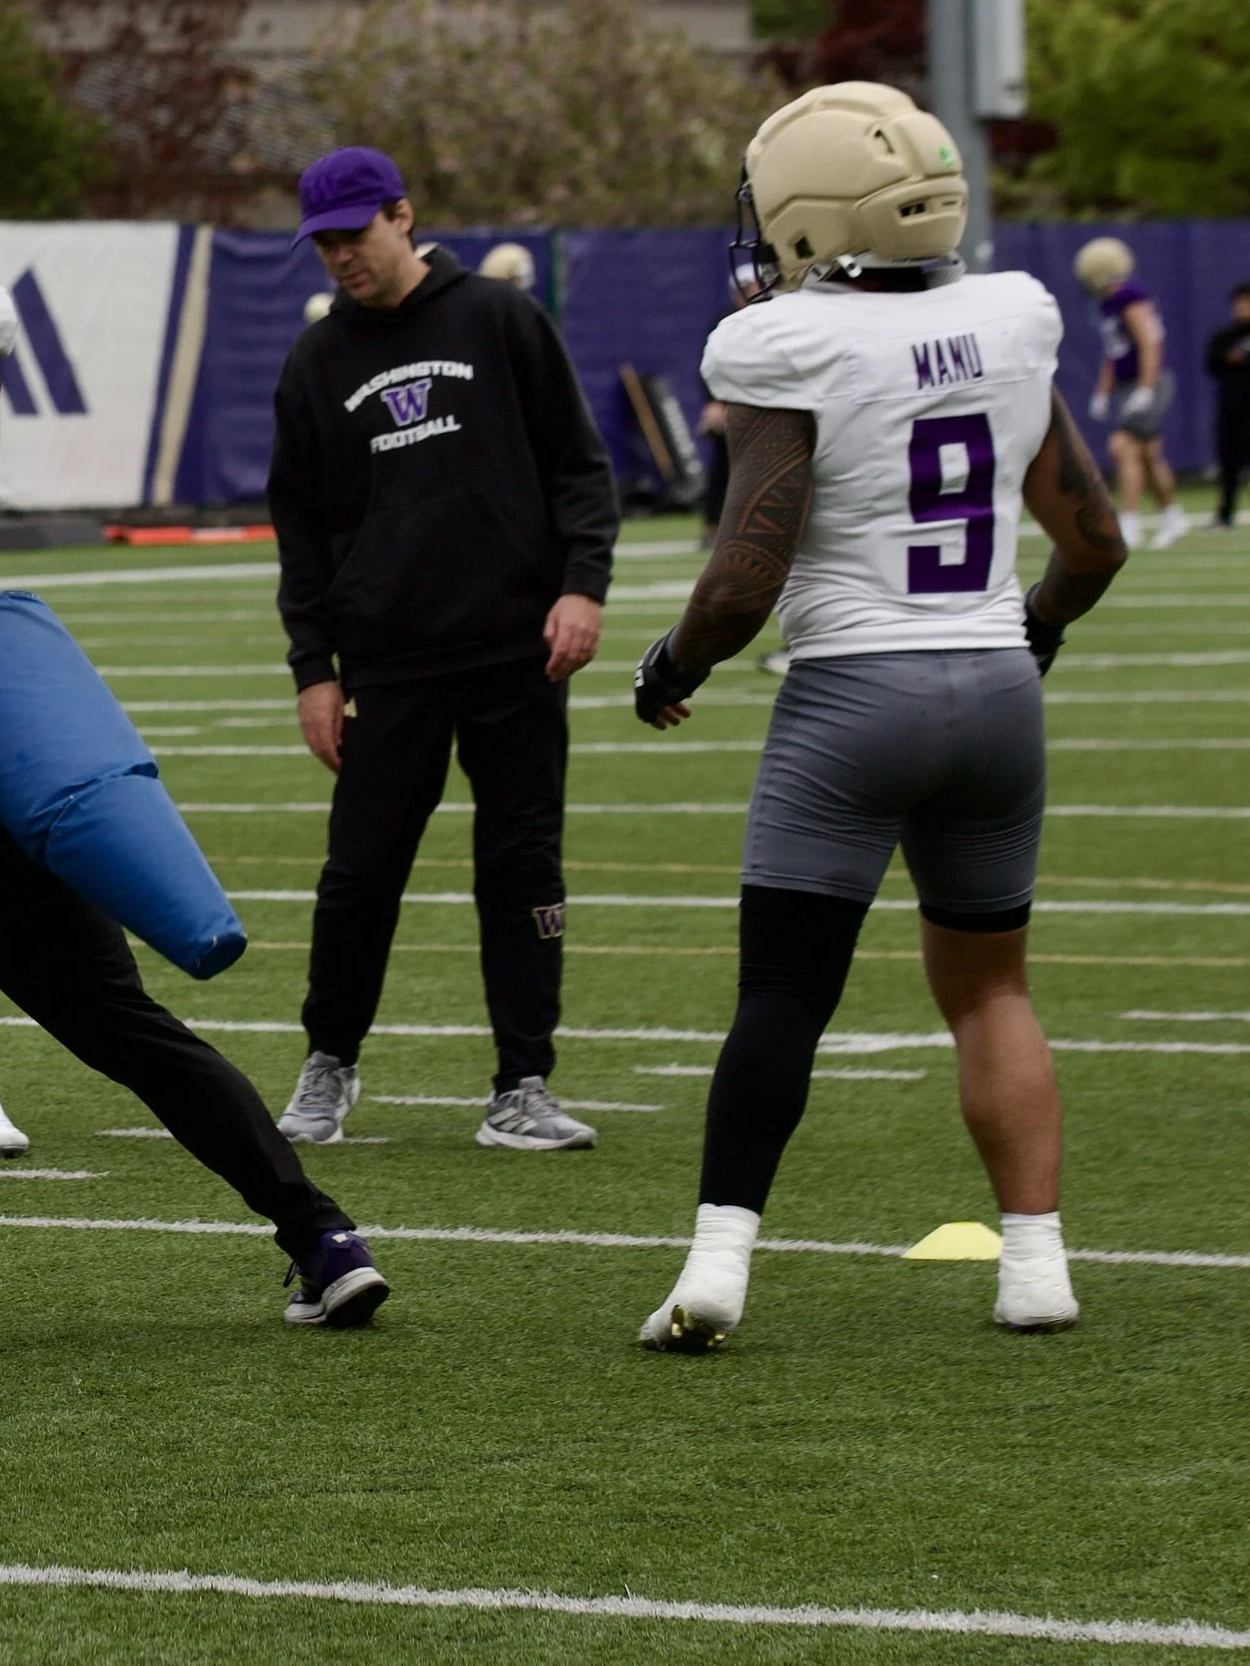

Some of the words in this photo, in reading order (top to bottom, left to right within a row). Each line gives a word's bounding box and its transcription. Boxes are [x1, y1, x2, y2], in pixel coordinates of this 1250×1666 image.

[911, 334, 985, 390] MANU
[380, 377, 433, 427] W
[370, 414, 463, 454] FOOTBALL
[906, 412, 996, 595] 9
[530, 901, 566, 940] W
